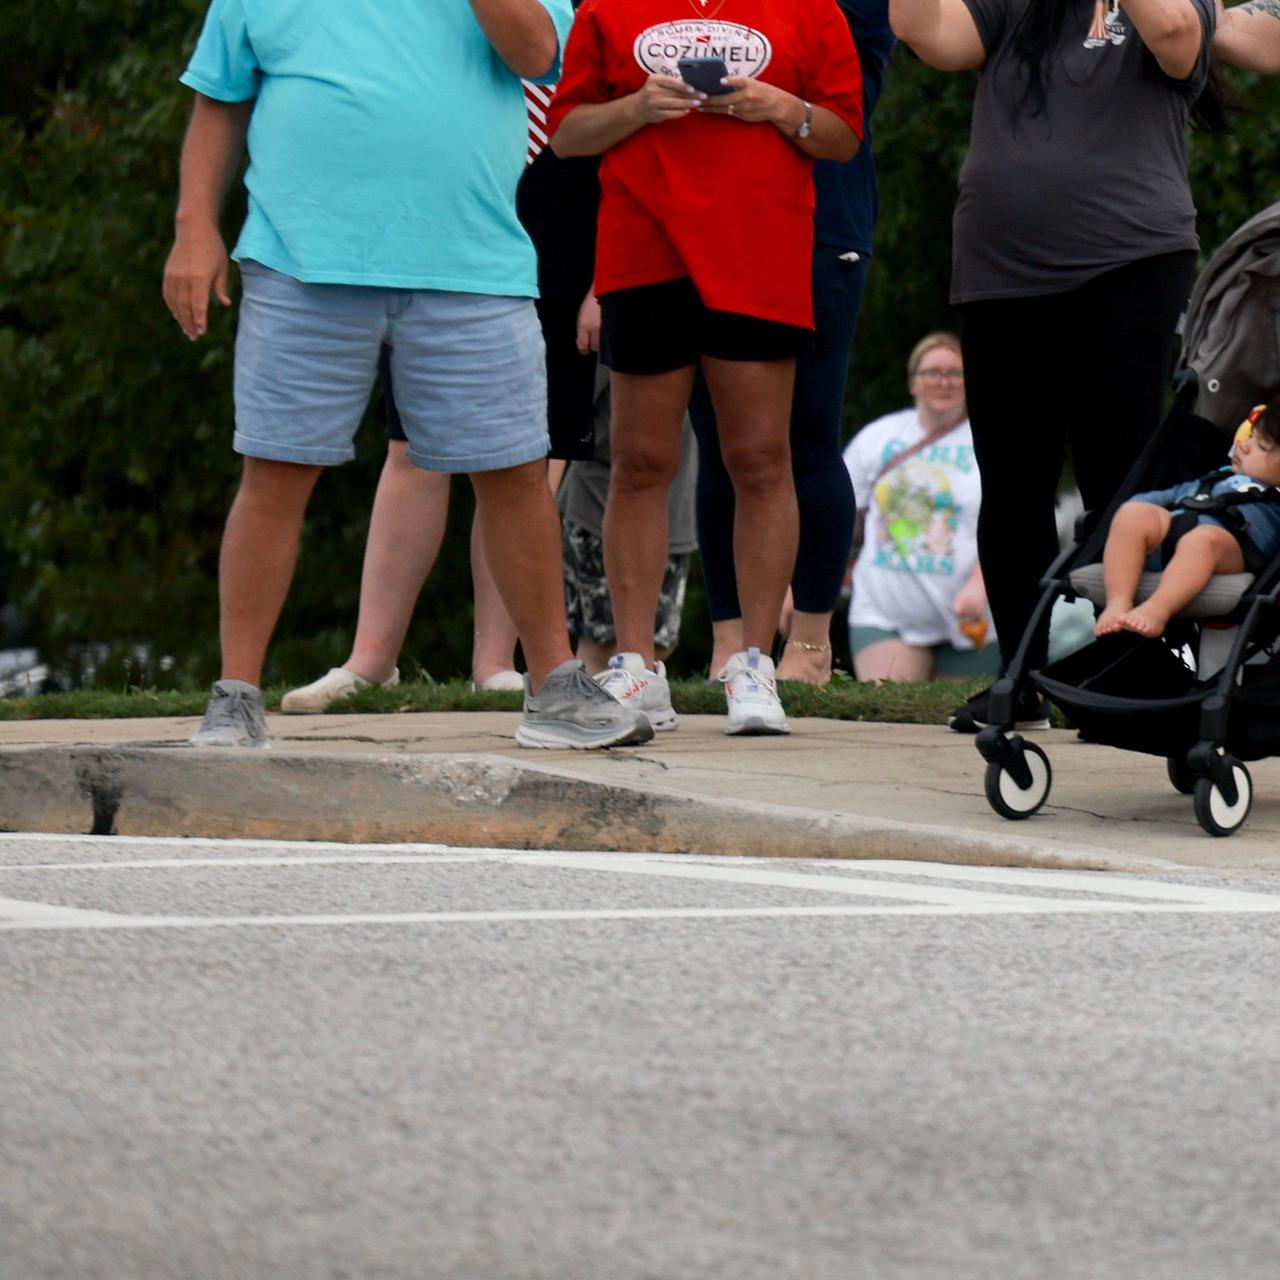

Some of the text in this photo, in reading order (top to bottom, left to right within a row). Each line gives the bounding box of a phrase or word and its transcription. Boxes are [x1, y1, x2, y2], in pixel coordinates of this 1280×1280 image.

[657, 25, 704, 37] SCUBA
[707, 25, 751, 41] DIVING
[648, 42, 757, 62] COZUMEL
